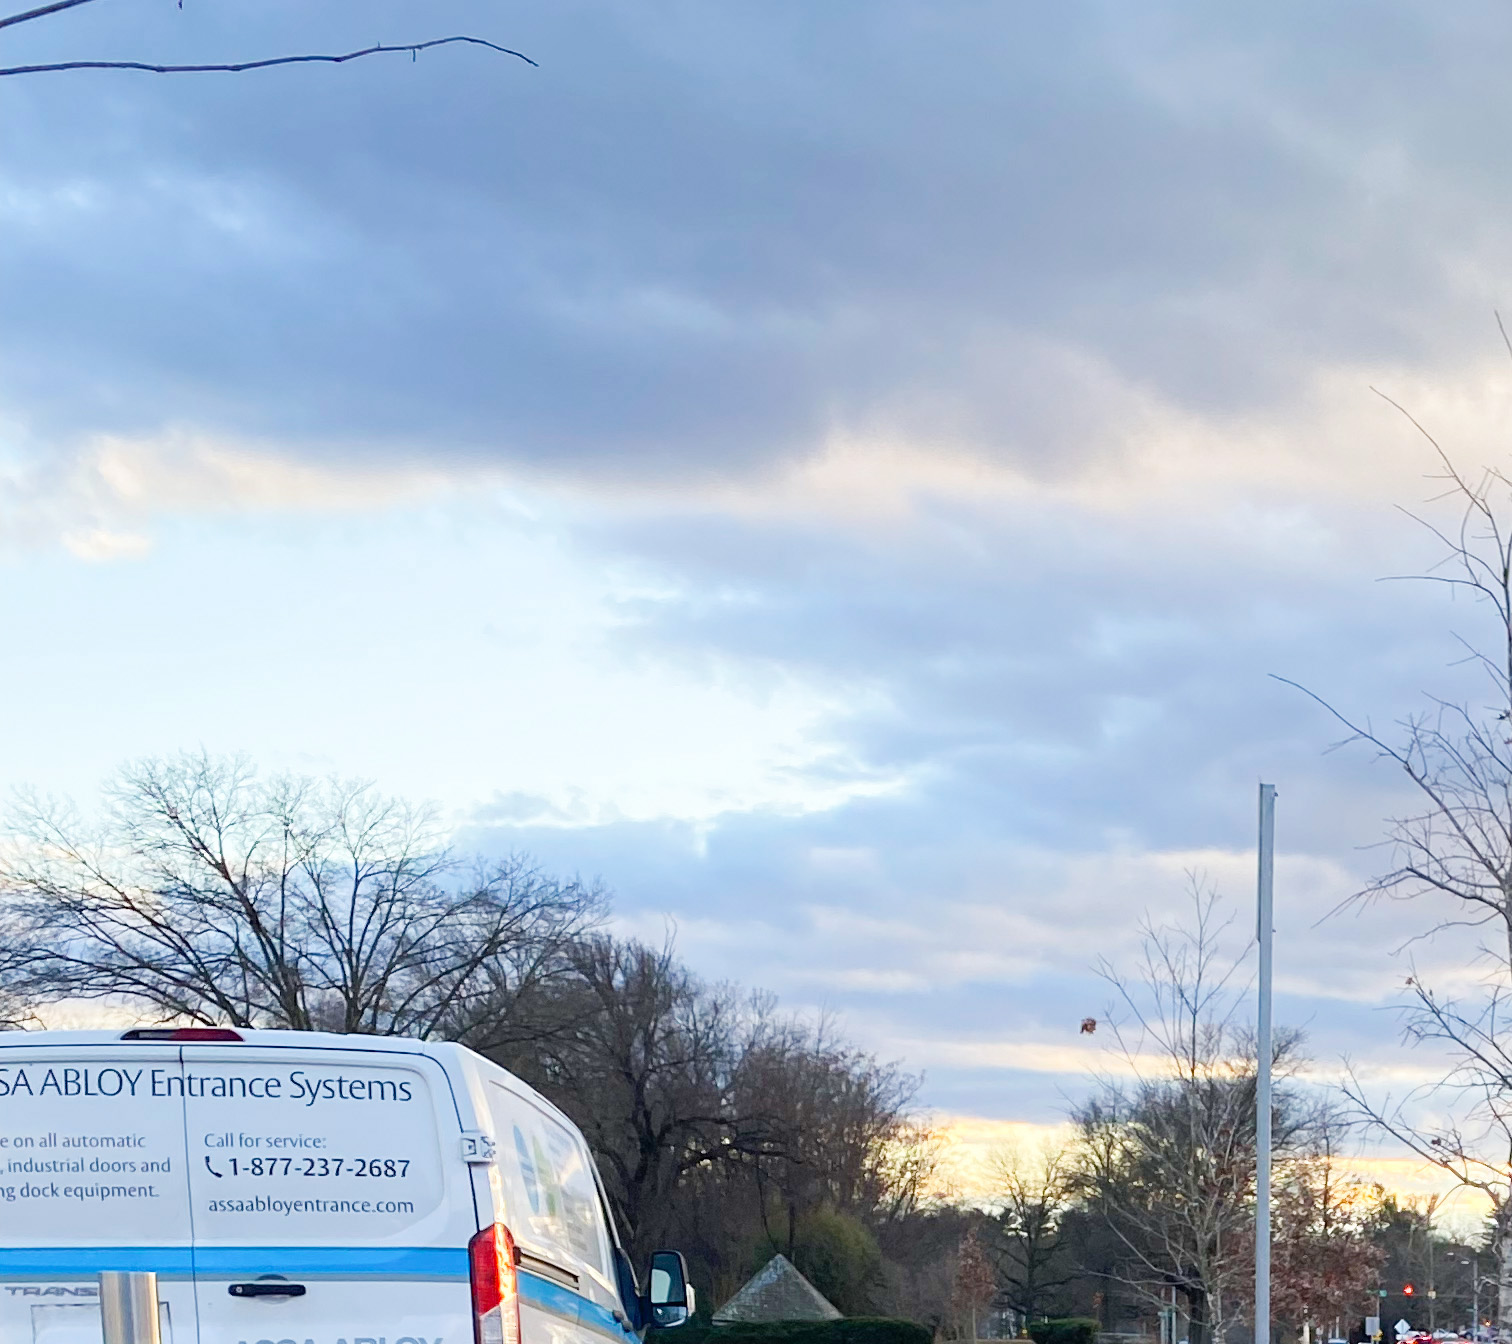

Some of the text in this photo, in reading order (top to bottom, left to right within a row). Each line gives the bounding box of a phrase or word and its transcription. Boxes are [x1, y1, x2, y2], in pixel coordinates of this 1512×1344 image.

[0, 1068, 412, 1107] SA ABLOY Entrance Systems
[13, 1136, 34, 1148] on
[39, 1133, 57, 1148] all
[62, 1133, 146, 1148] automatic
[204, 1133, 327, 1149] Call for service:
[7, 1157, 171, 1173] industrial doors and
[228, 1157, 410, 1178] 1-877-237-2687
[20, 1182, 60, 1198] dock
[64, 1182, 160, 1201] equipment.
[208, 1195, 414, 1216] assaabloyentrance.com
[4, 1286, 98, 1296] TRANS
